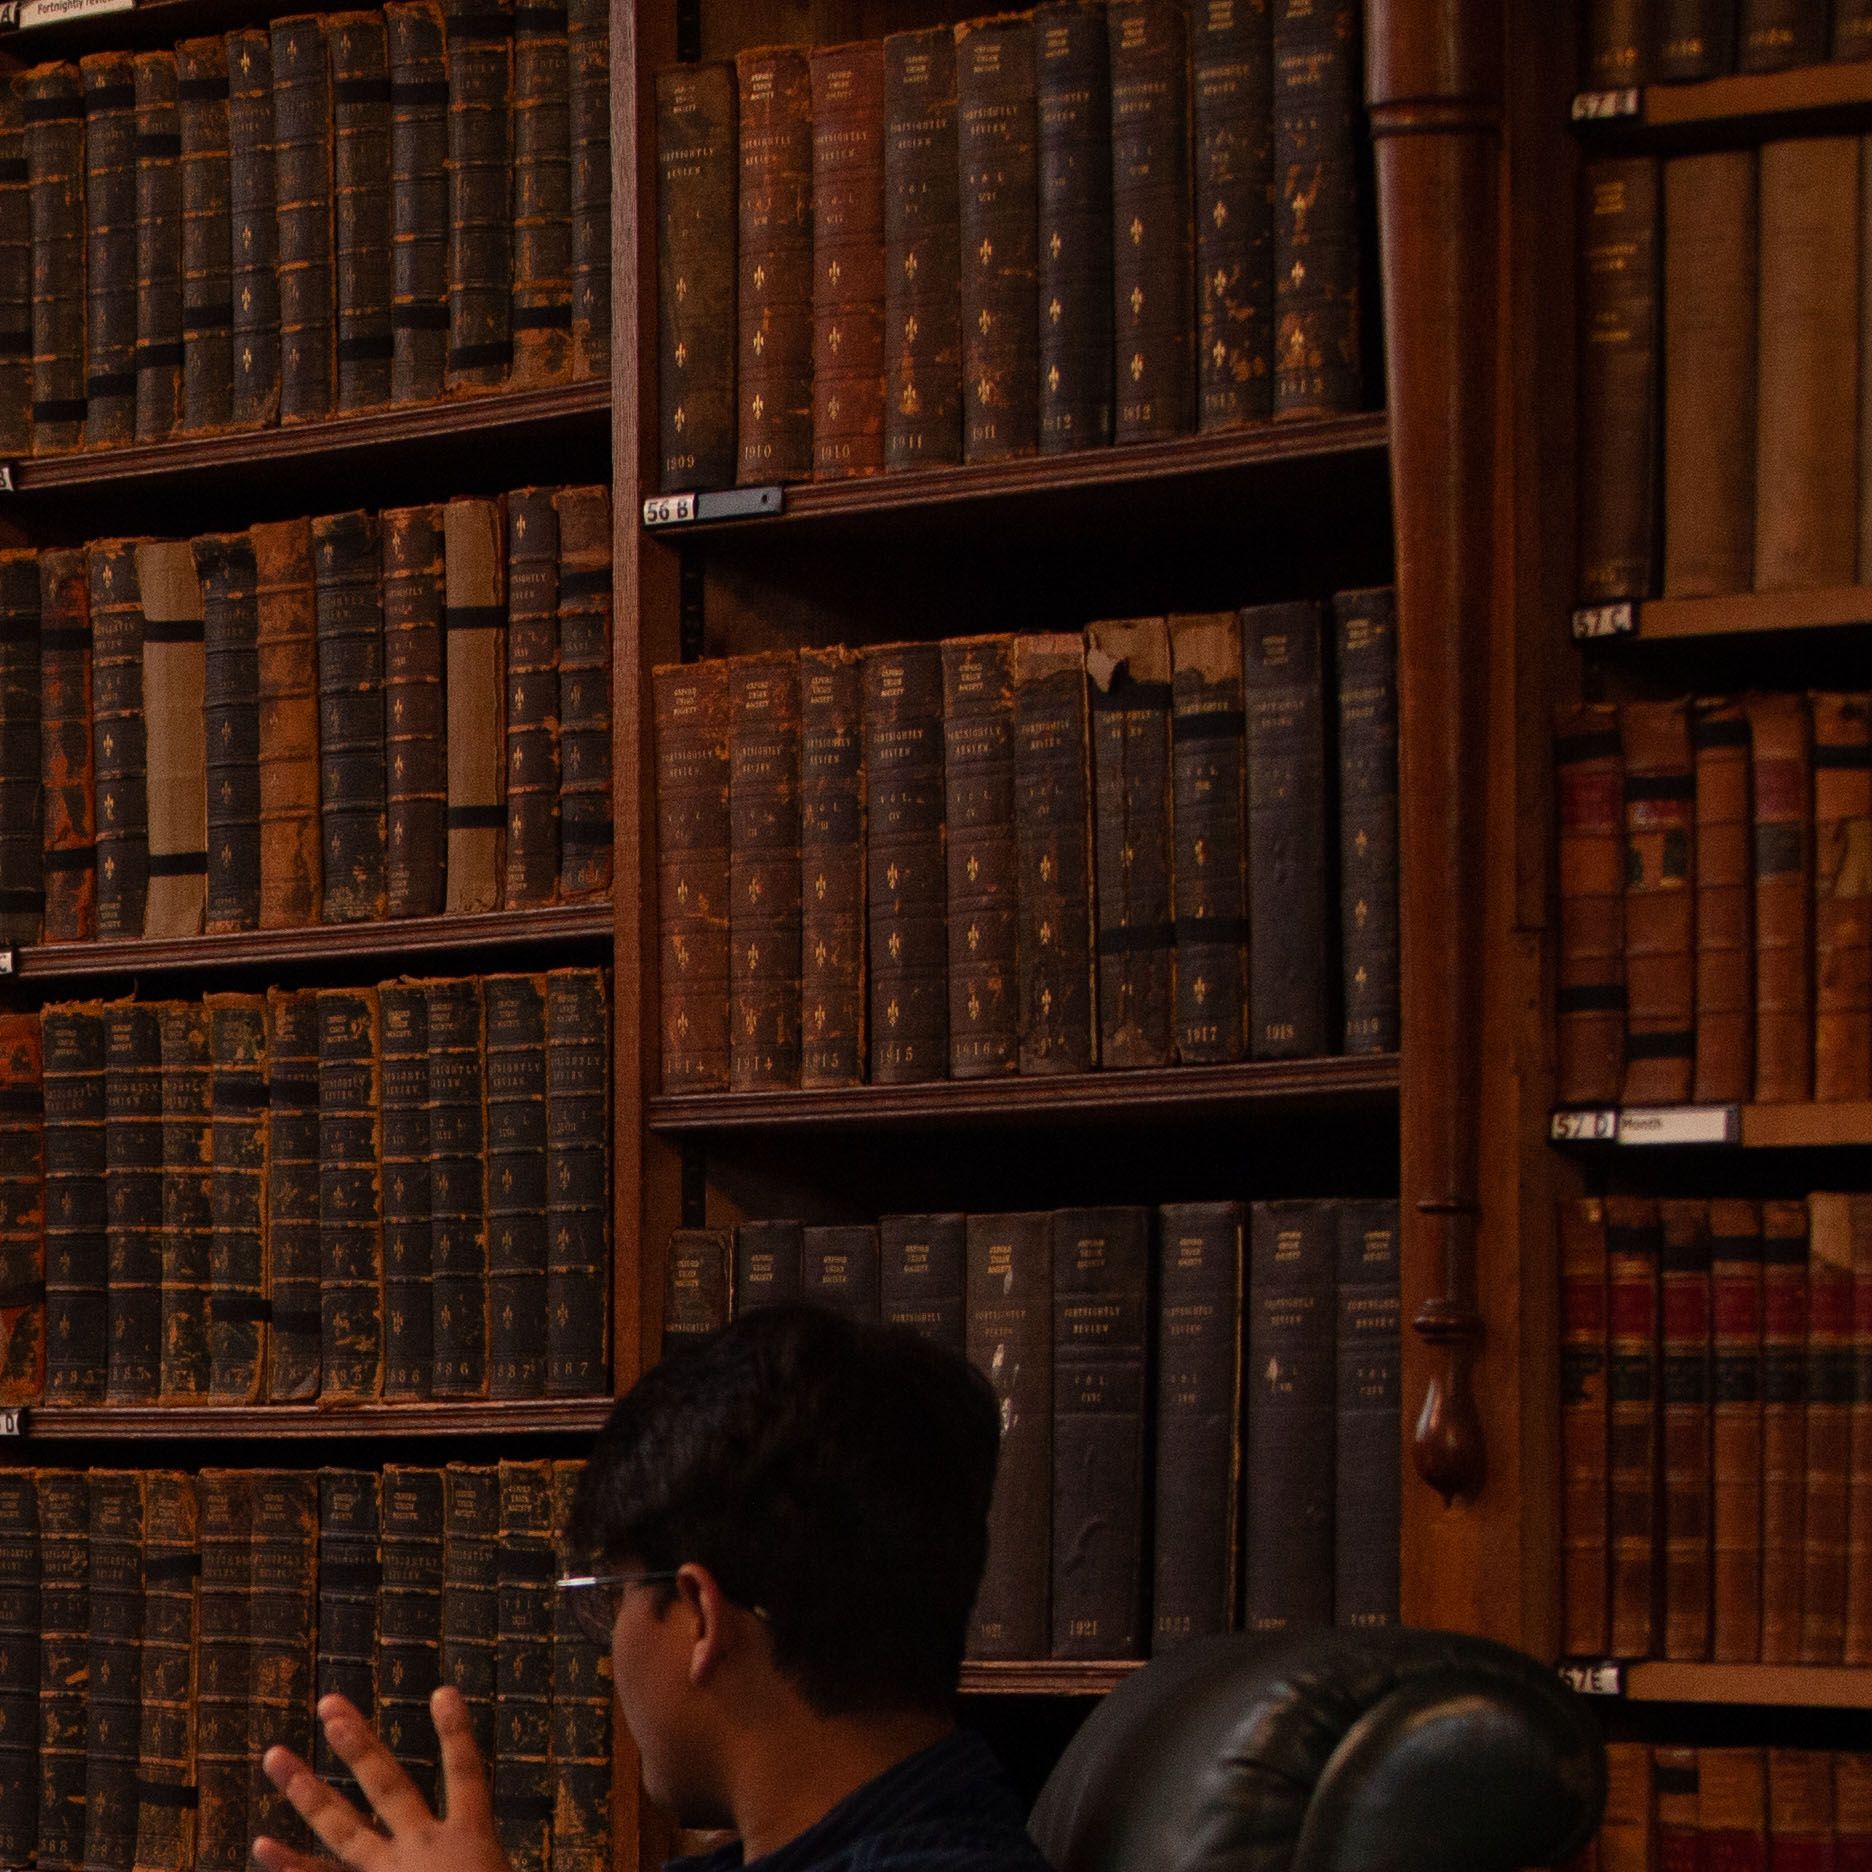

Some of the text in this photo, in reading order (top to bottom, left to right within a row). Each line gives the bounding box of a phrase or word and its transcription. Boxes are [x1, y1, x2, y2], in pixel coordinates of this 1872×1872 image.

[1, 6, 9, 22] A
[744, 444, 773, 461] 1910
[821, 444, 851, 461] 1910
[647, 500, 688, 521] 56 B
[1185, 1025, 1218, 1042] 1917
[1264, 1022, 1296, 1040] 1918
[803, 1052, 839, 1069] 1915
[878, 1047, 915, 1065] 1915
[666, 1059, 706, 1075] 1914
[736, 1056, 773, 1074] 1914
[1063, 1305, 1121, 1318] FORTNIGHTLY
[1072, 1323, 1112, 1335] REVIEW
[1069, 1619, 1098, 1637] 1921
